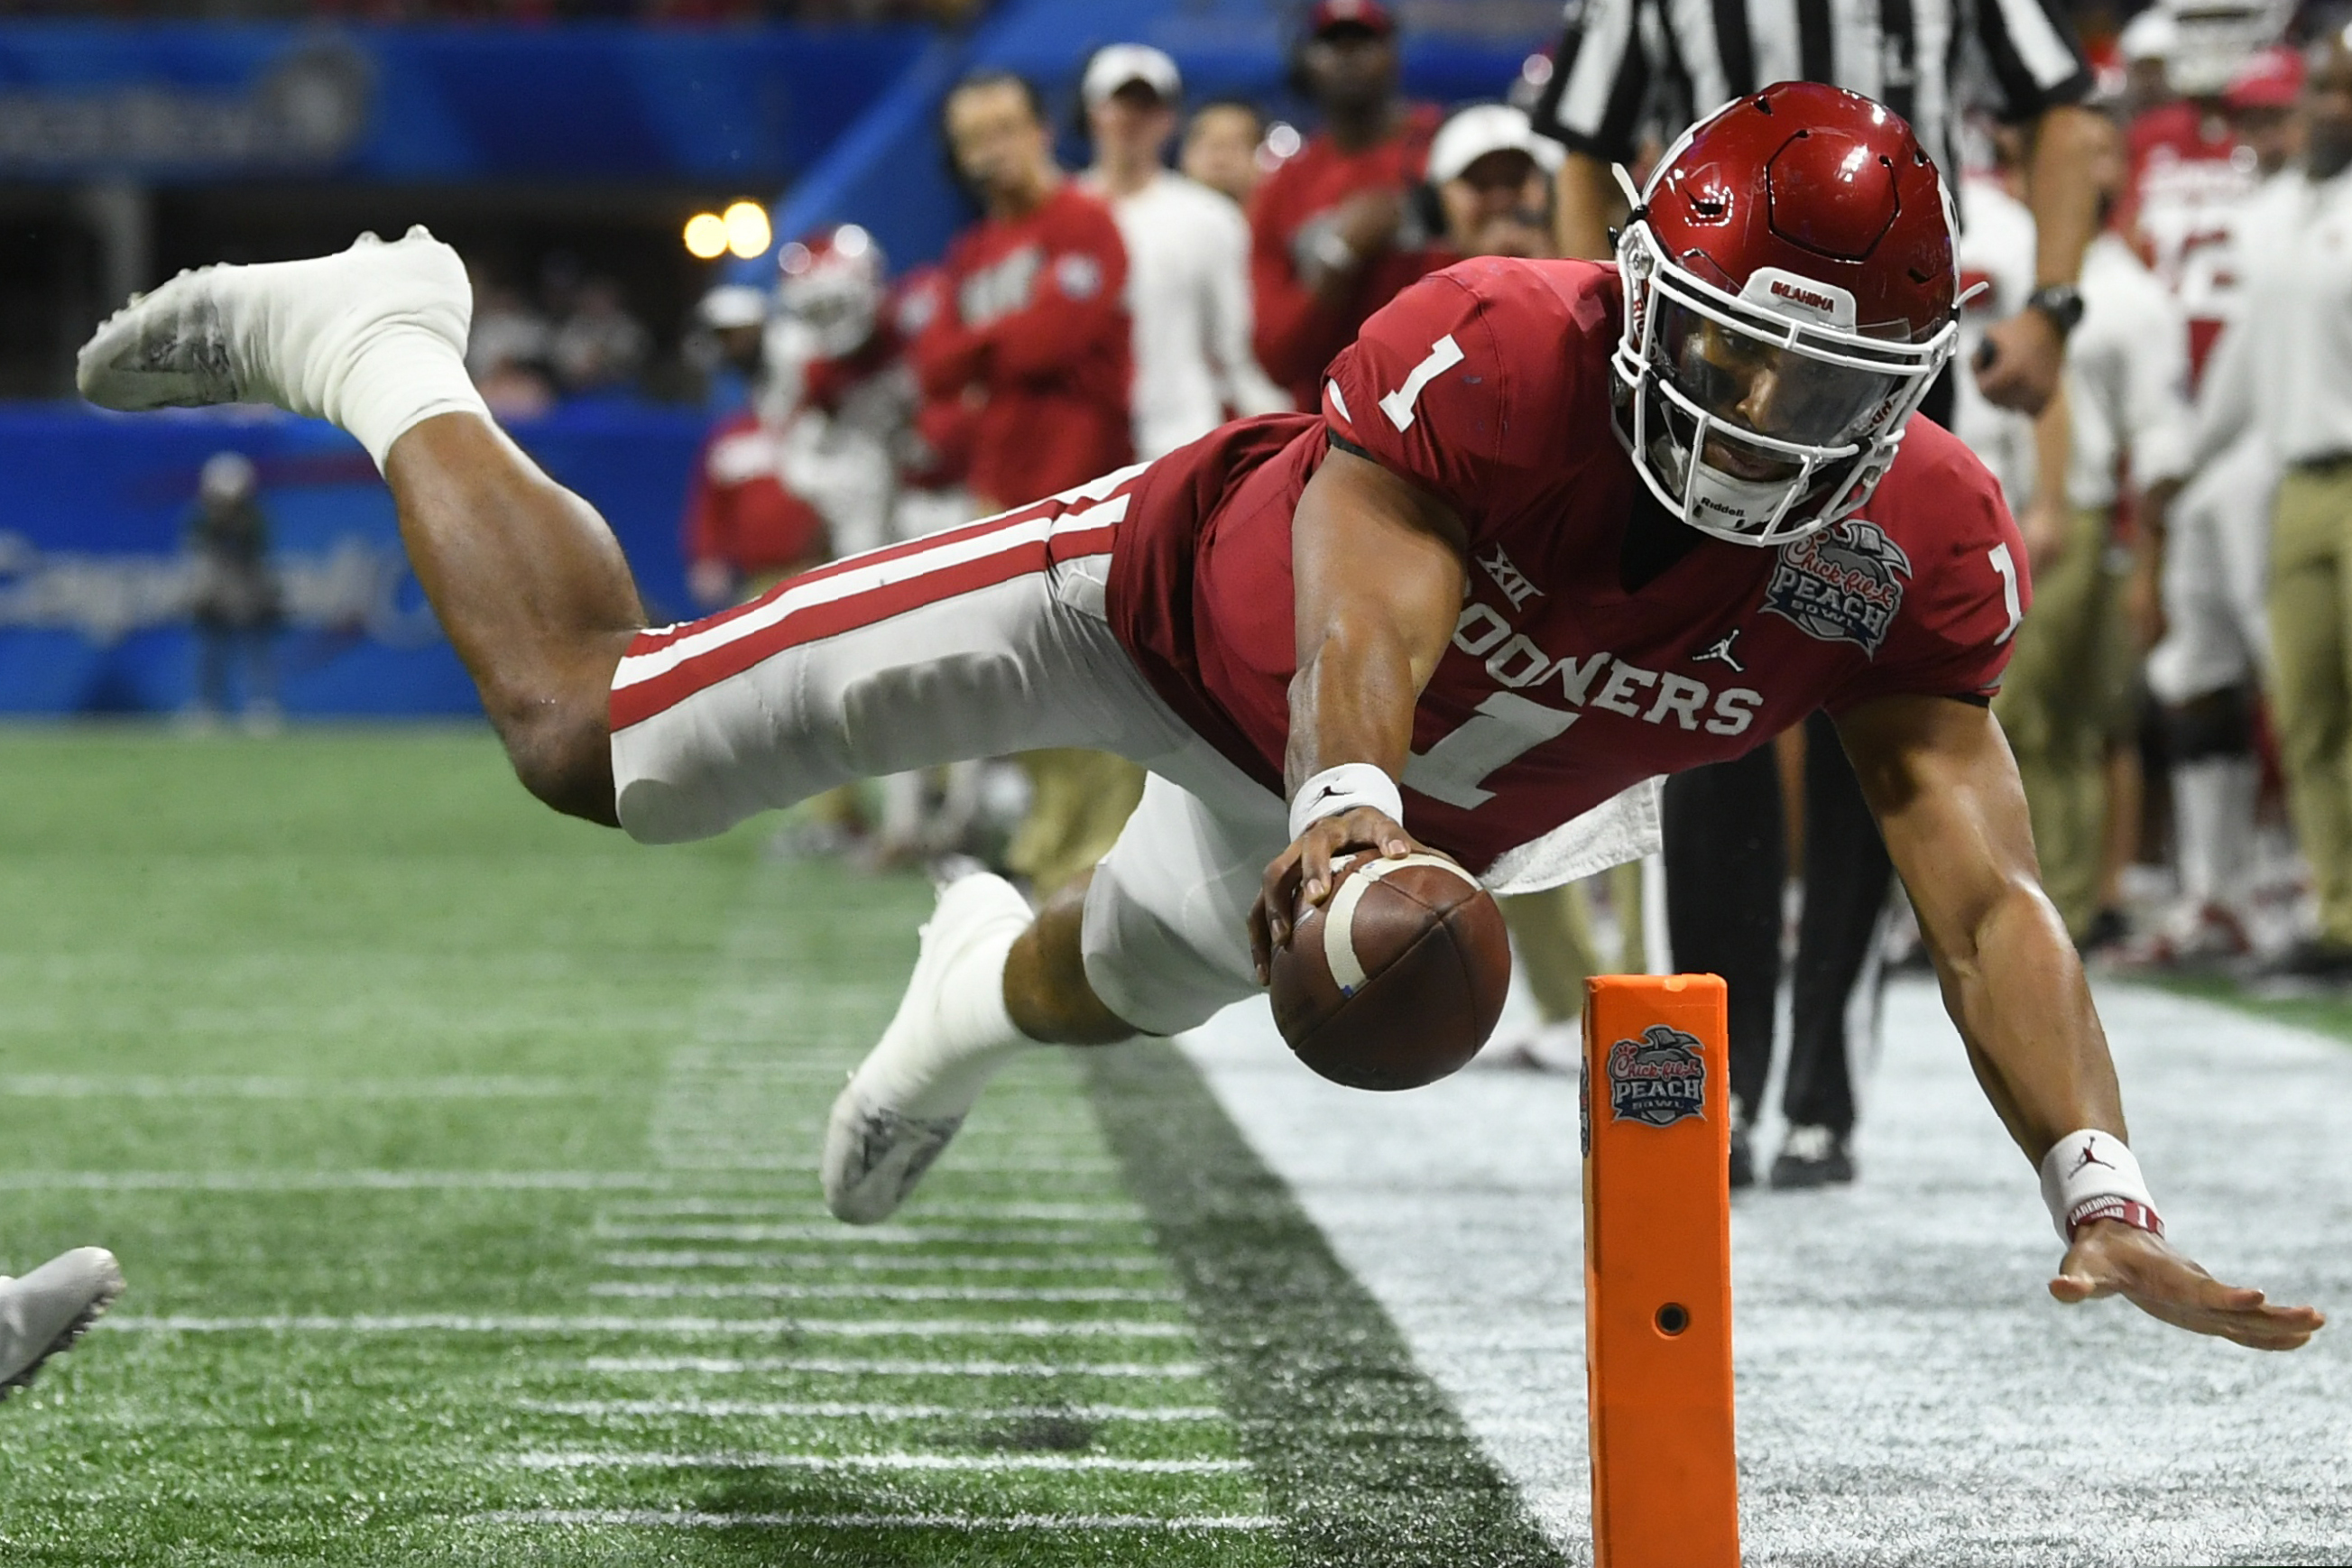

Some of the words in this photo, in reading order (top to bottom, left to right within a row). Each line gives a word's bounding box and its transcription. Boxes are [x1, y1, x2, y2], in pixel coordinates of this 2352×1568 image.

[1770, 281, 1834, 313] OKLAHOMA
[1378, 333, 1465, 433] 1
[1701, 496, 1745, 517] Riddell
[1772, 566, 1888, 637] PEACH
[1791, 600, 1857, 632] BOWL
[1988, 541, 2024, 646] 1
[1452, 582, 1764, 736] OONERS
[1400, 691, 1582, 810] 1
[1616, 1079, 1701, 1103] PEACH
[1632, 1100, 1685, 1110] BOWL
